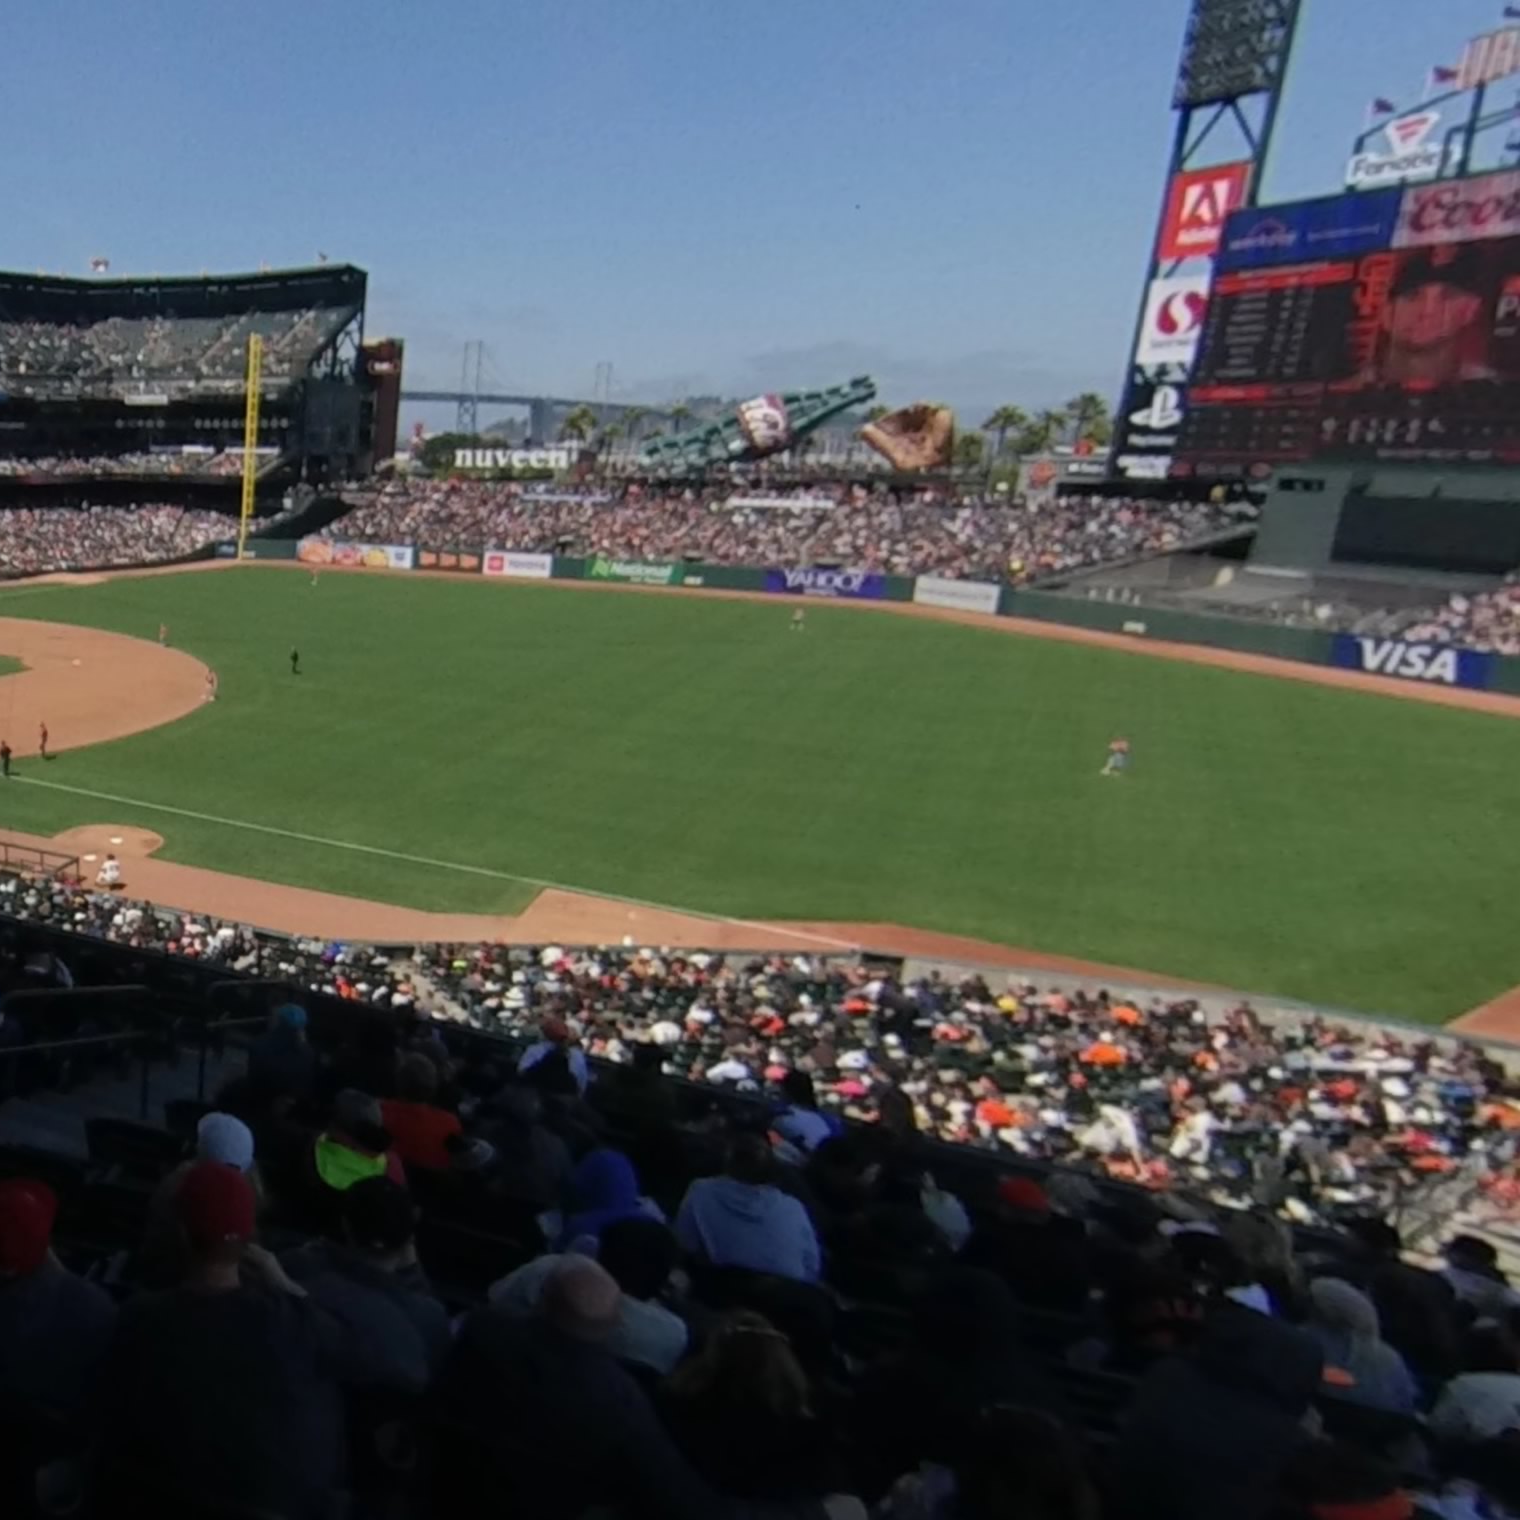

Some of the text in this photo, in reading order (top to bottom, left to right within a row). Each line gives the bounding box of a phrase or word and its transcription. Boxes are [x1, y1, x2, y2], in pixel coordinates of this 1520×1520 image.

[454, 447, 568, 469] nuveen
[610, 559, 674, 577] National
[1356, 637, 1457, 683] VISA
